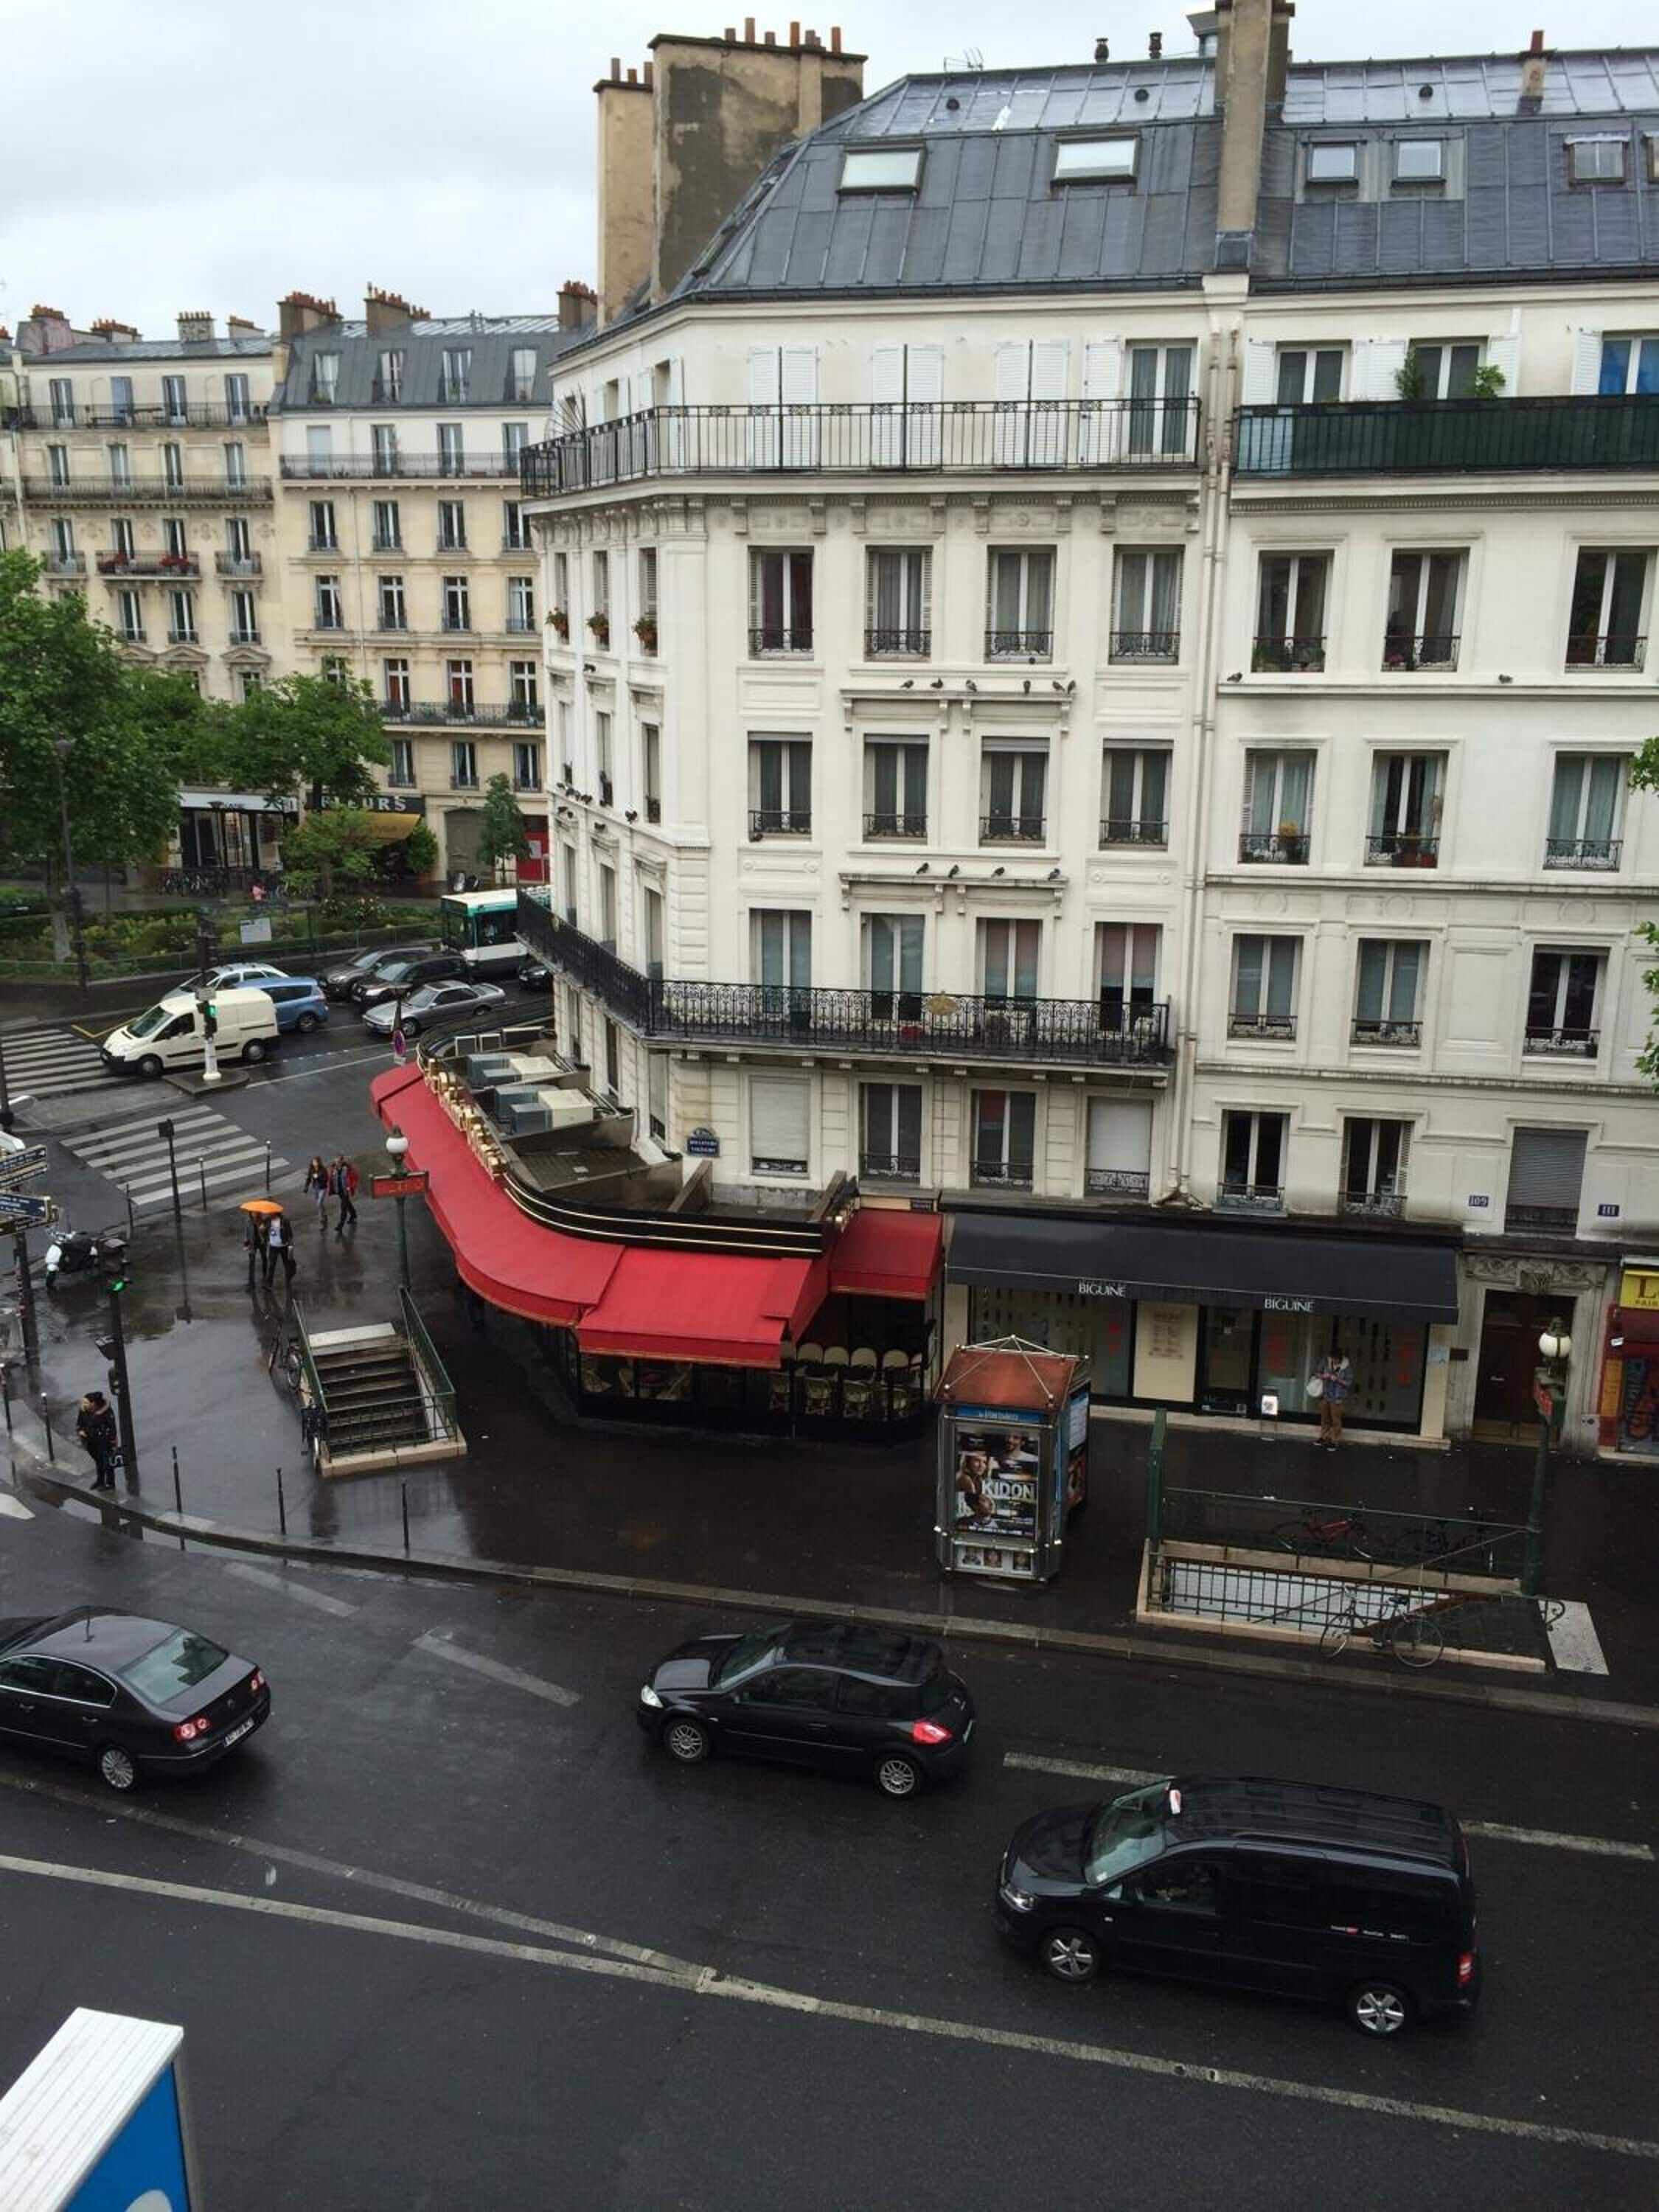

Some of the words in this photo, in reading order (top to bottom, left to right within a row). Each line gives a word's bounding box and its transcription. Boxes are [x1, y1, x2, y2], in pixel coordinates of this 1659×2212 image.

[1079, 1282, 1127, 1298] BIGUINE
[1265, 1298, 1315, 1313] BIGUINE
[981, 1480, 1036, 1500] KIDON
